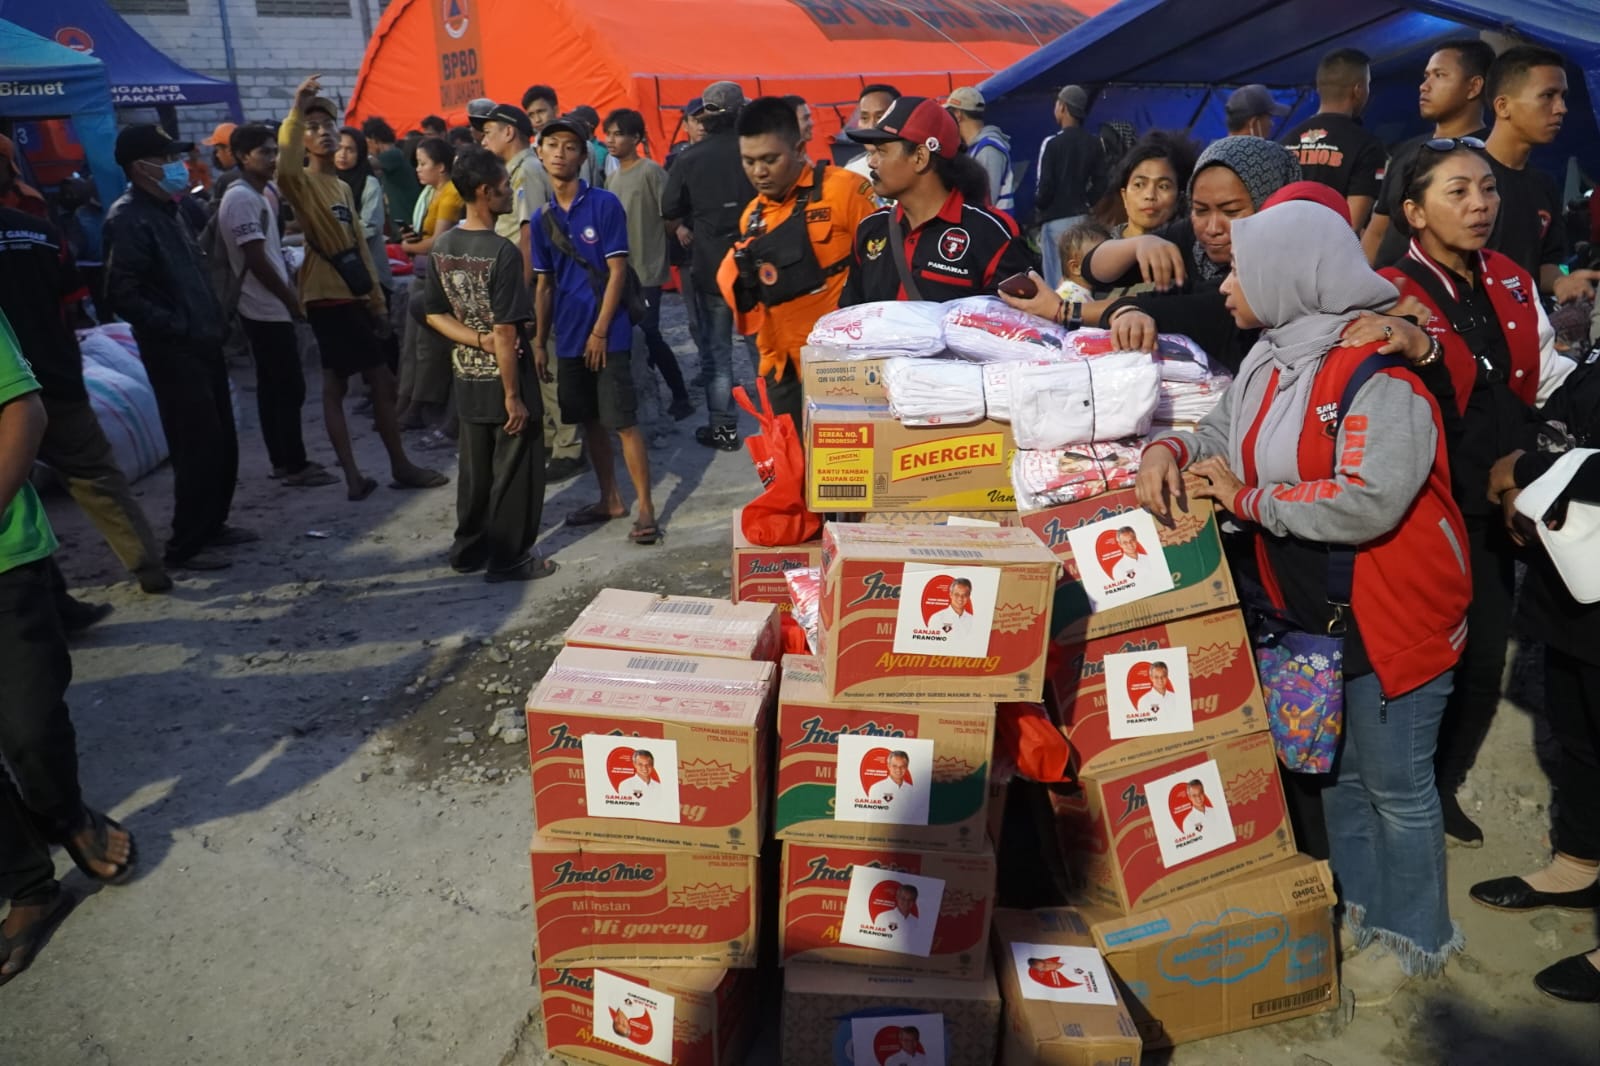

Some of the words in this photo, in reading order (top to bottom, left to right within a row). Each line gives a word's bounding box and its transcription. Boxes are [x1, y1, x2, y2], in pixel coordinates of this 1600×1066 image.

[442, 48, 477, 80] BPBD
[0, 81, 65, 96] Biznet
[858, 426, 868, 444] 1
[900, 442, 996, 471] ENERGEN
[875, 652, 927, 672] Ayam
[621, 923, 708, 939] goreng
